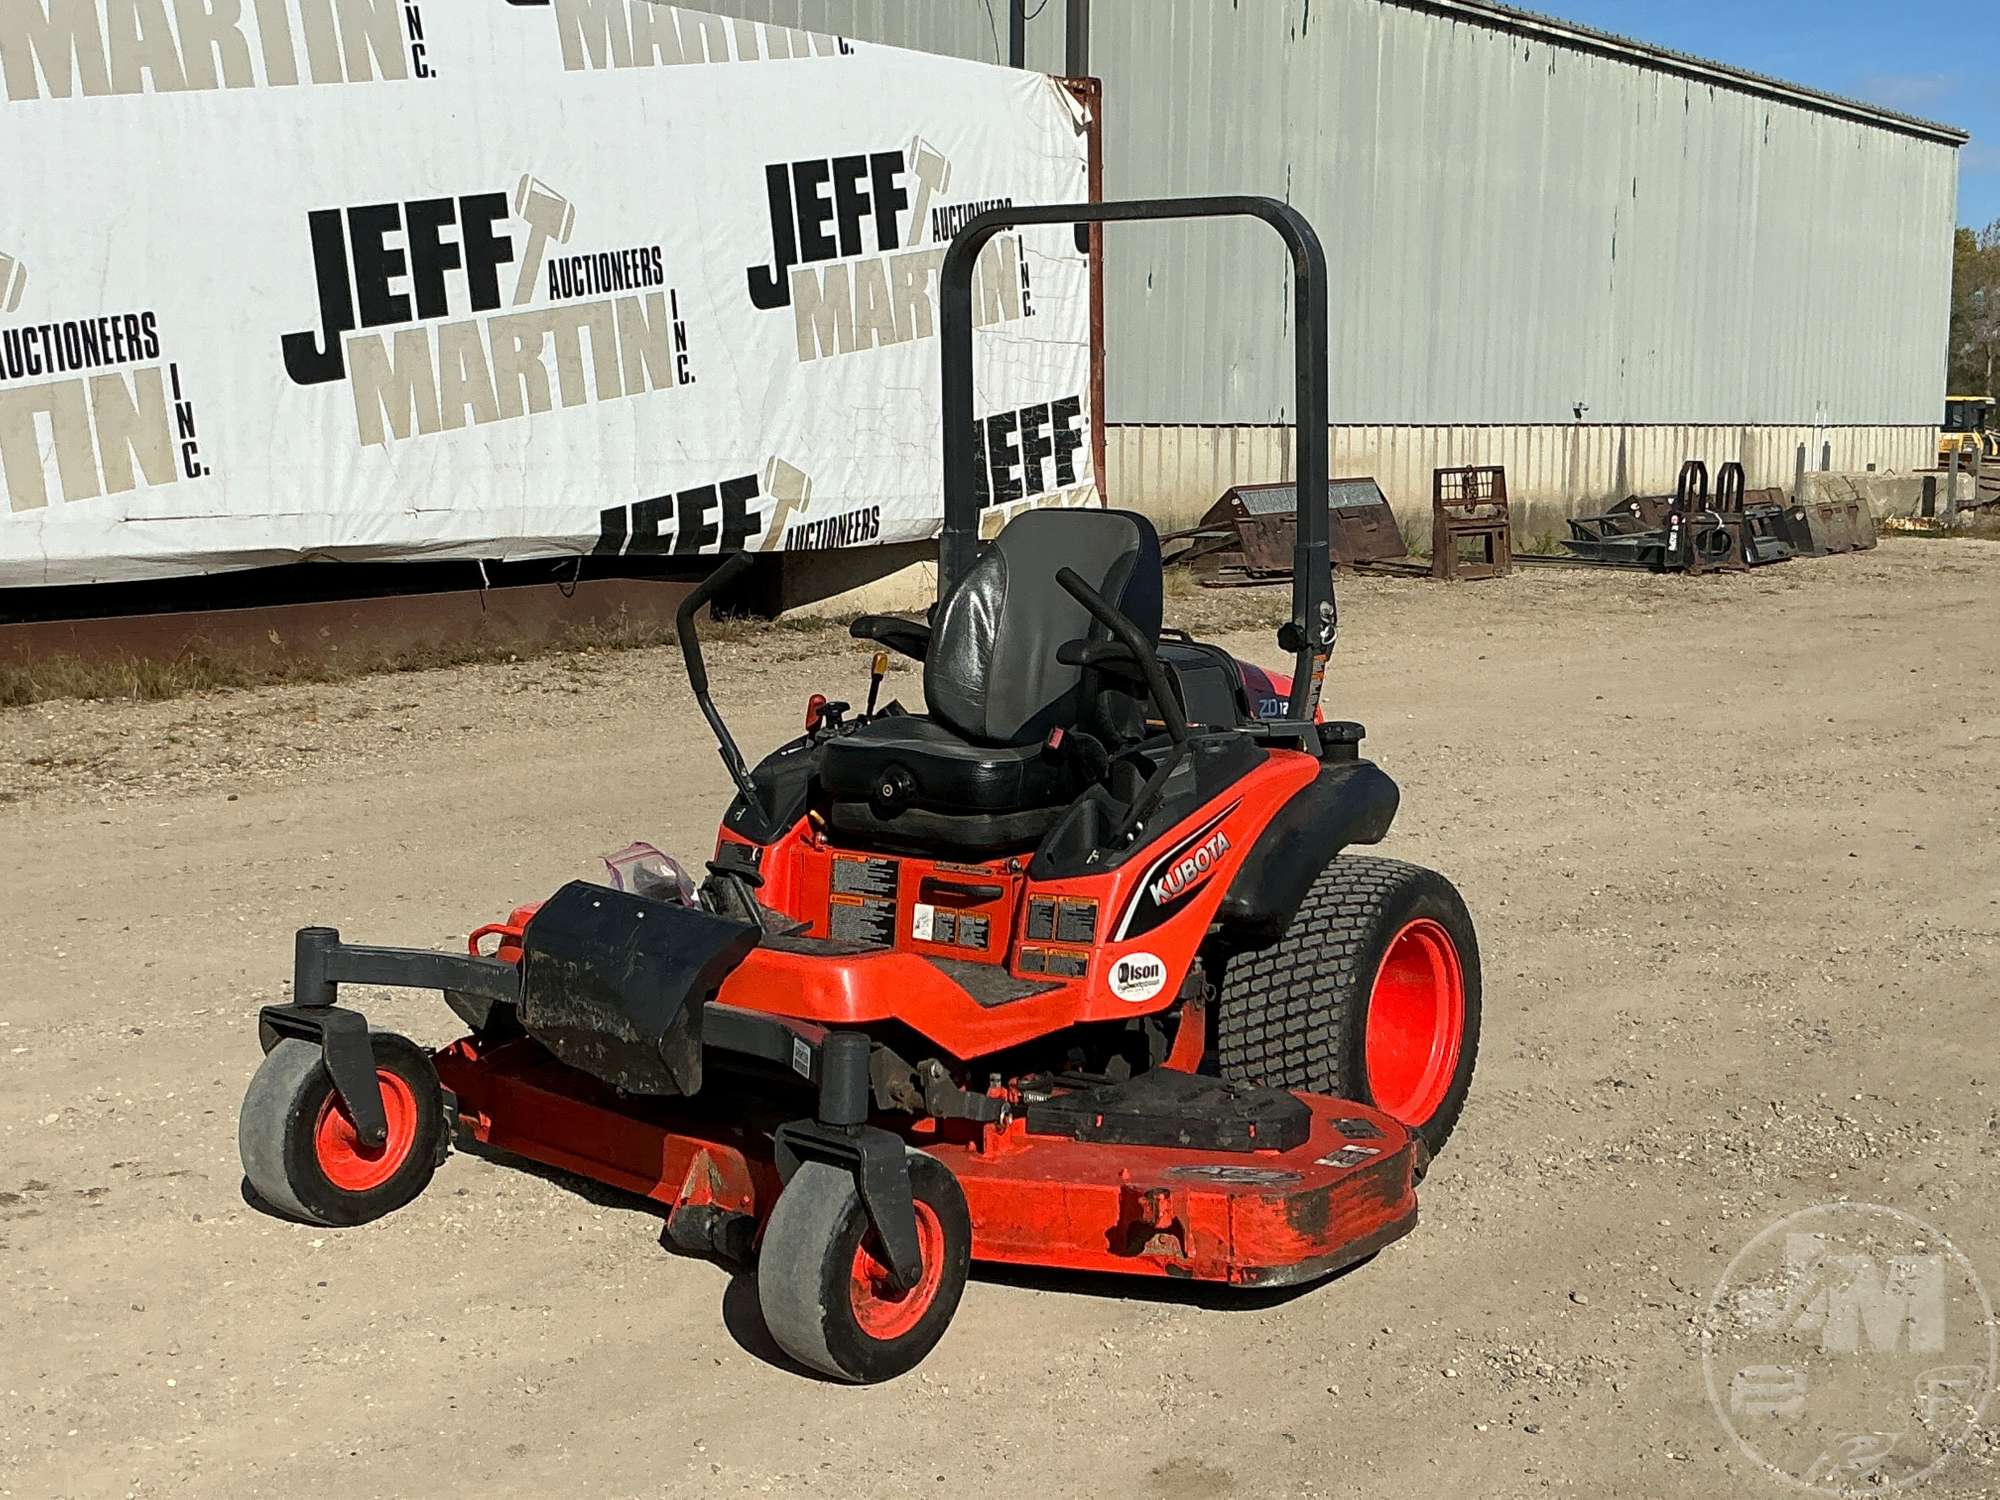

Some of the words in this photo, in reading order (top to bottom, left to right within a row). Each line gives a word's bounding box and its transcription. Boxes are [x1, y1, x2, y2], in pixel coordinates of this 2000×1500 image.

[404, 0, 437, 79] NC.
[548, 246, 664, 302] AUCTIONEERS
[747, 150, 909, 310] JEFF
[281, 192, 515, 386] JEFF
[670, 289, 696, 385] INC.
[347, 290, 674, 447] MARTIN
[170, 363, 210, 479] INC.
[1149, 831, 1231, 907] KUBOTA
[1117, 962, 1160, 984] Olson
